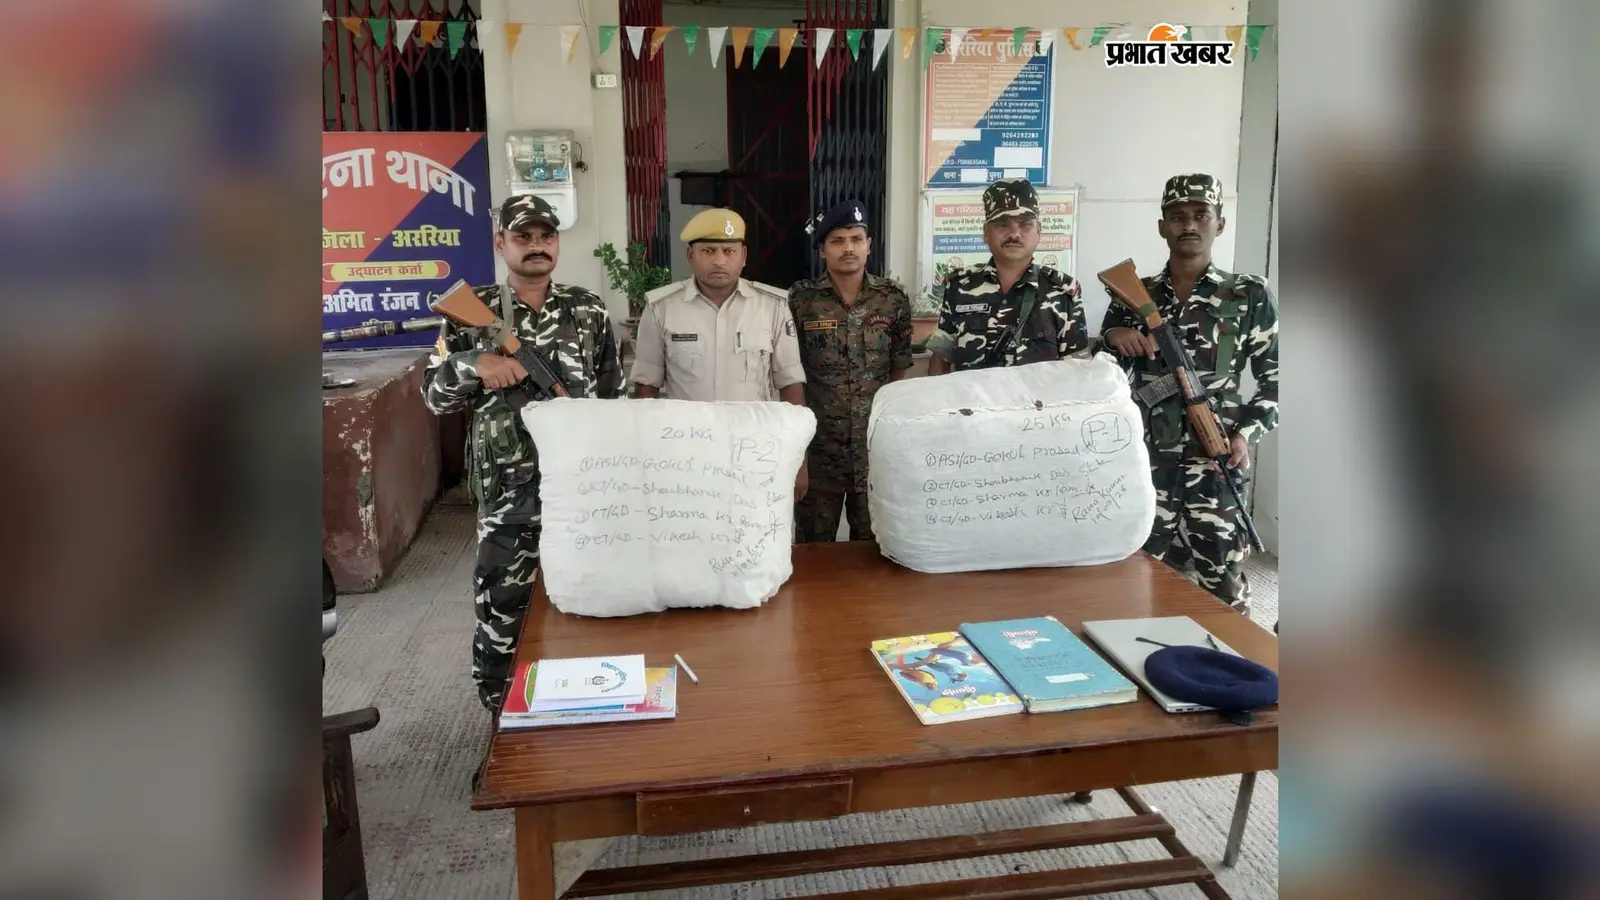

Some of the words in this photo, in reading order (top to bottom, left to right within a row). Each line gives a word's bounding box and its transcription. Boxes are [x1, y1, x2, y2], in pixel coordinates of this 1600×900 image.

[385, 150, 476, 216] थाना
[392, 225, 460, 247] अररिया
[323, 289, 374, 313] अमित
[379, 287, 420, 310] रंजन
[660, 426, 684, 440] 20
[690, 427, 713, 441] KG
[1022, 416, 1045, 432] 25
